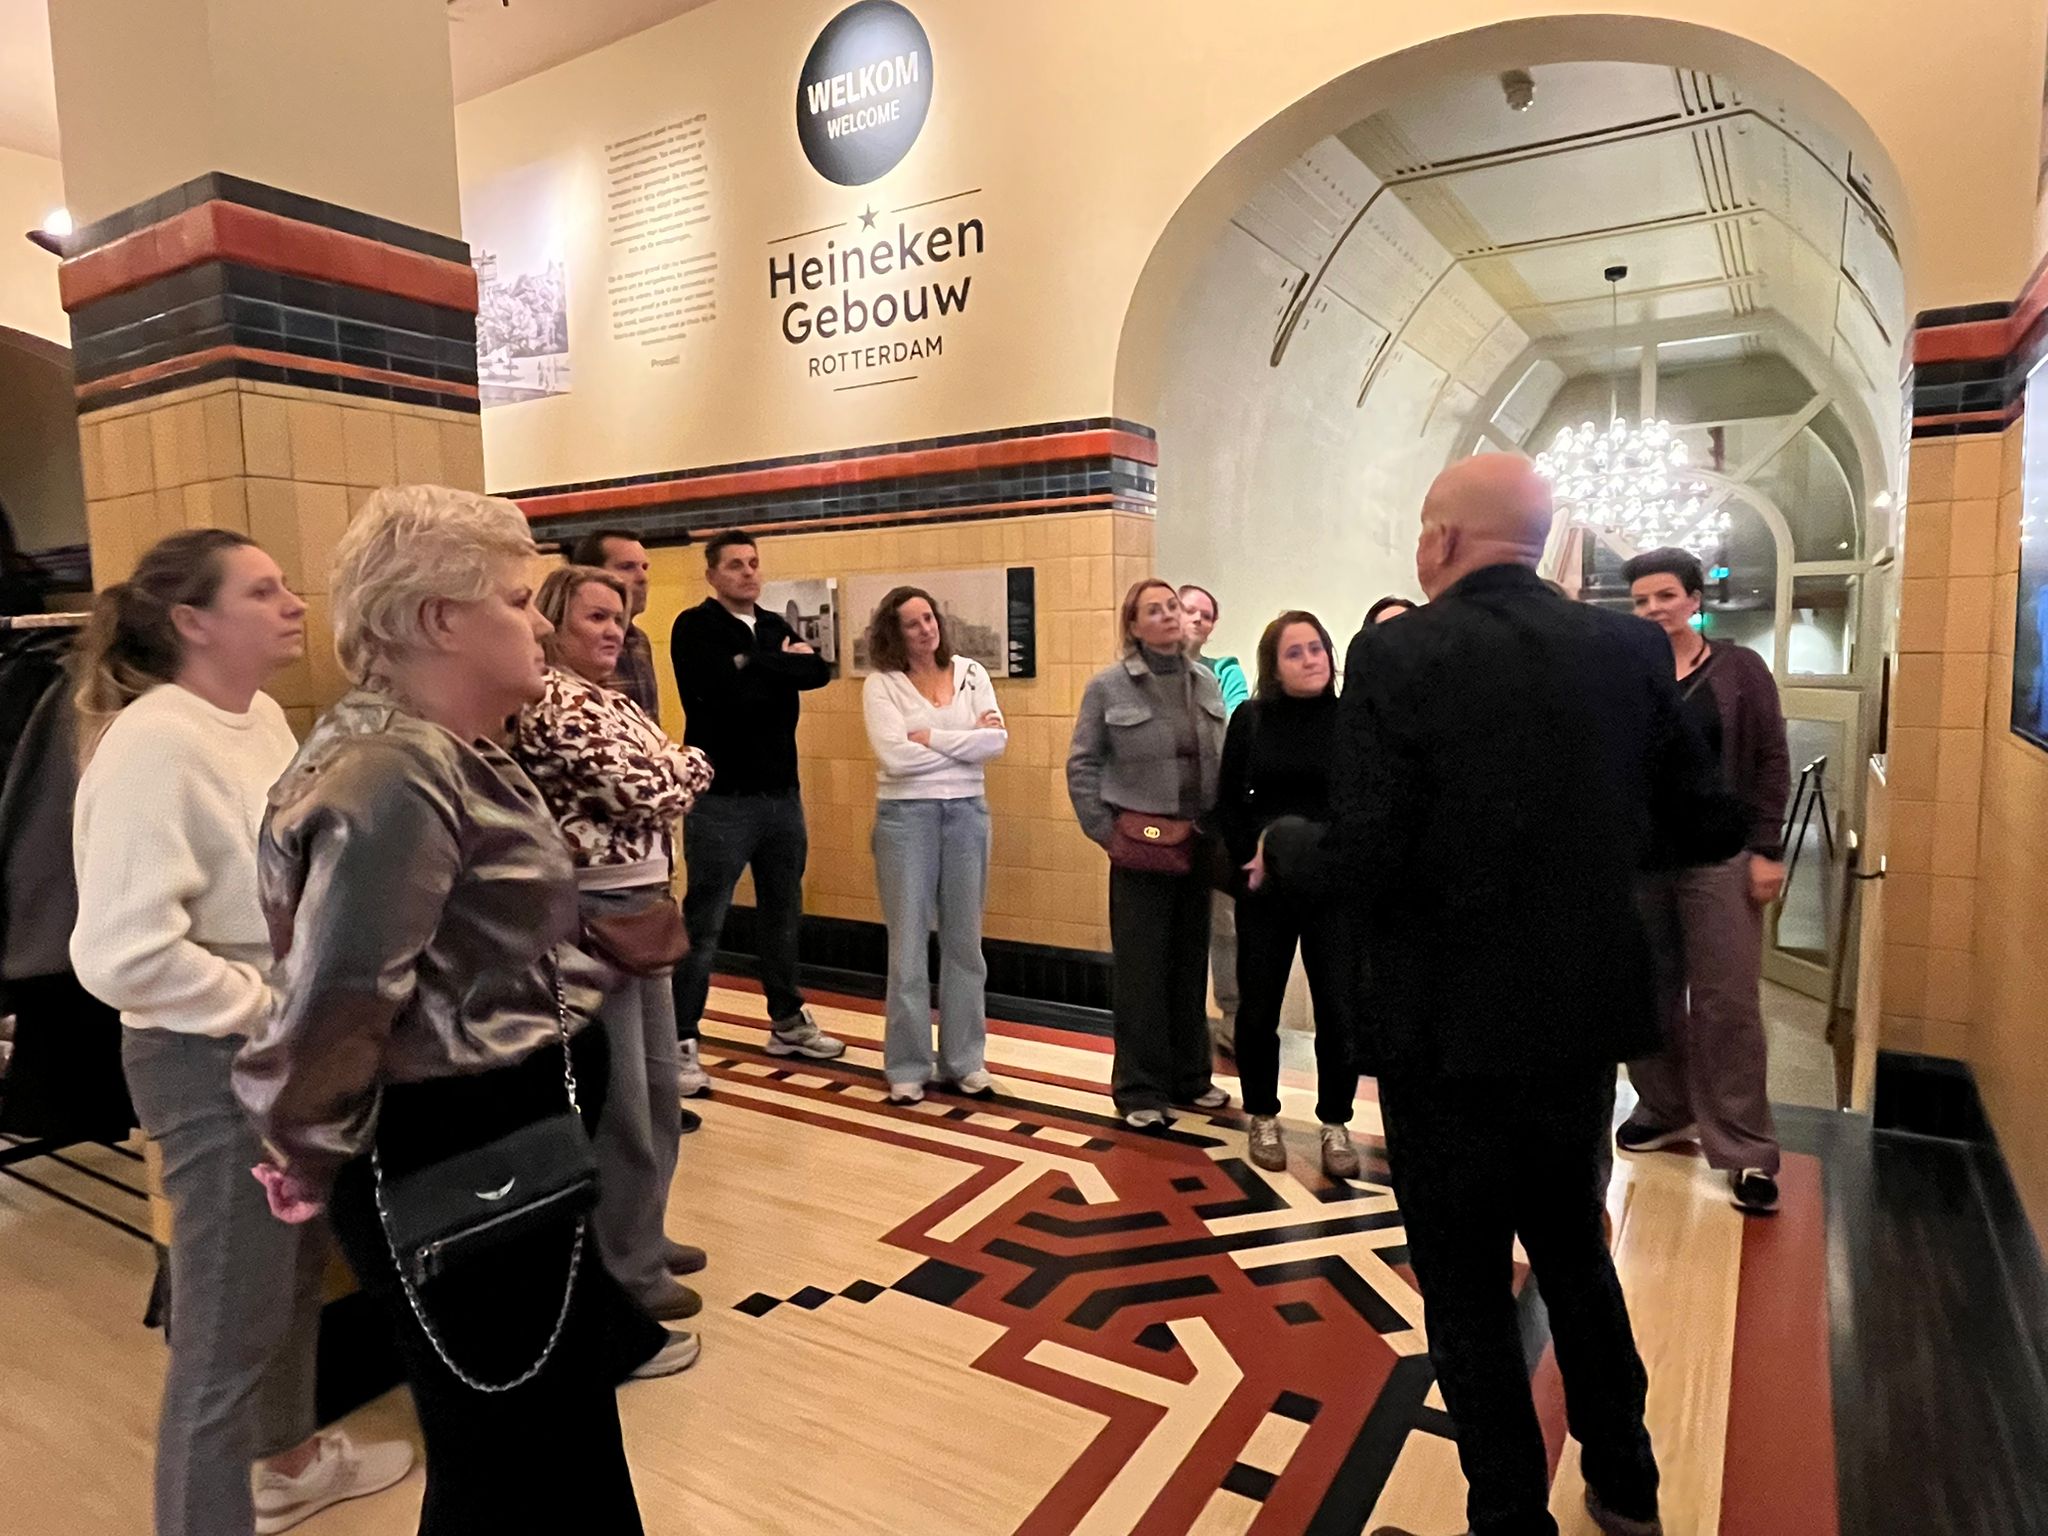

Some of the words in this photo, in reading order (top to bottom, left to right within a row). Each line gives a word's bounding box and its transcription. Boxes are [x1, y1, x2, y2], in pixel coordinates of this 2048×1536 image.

[807, 51, 919, 115] WELKOM
[827, 100, 900, 139] WELCOME
[769, 218, 984, 299] Heineken
[782, 276, 971, 344] Gebouw
[809, 335, 942, 377] ROTTERDAM
